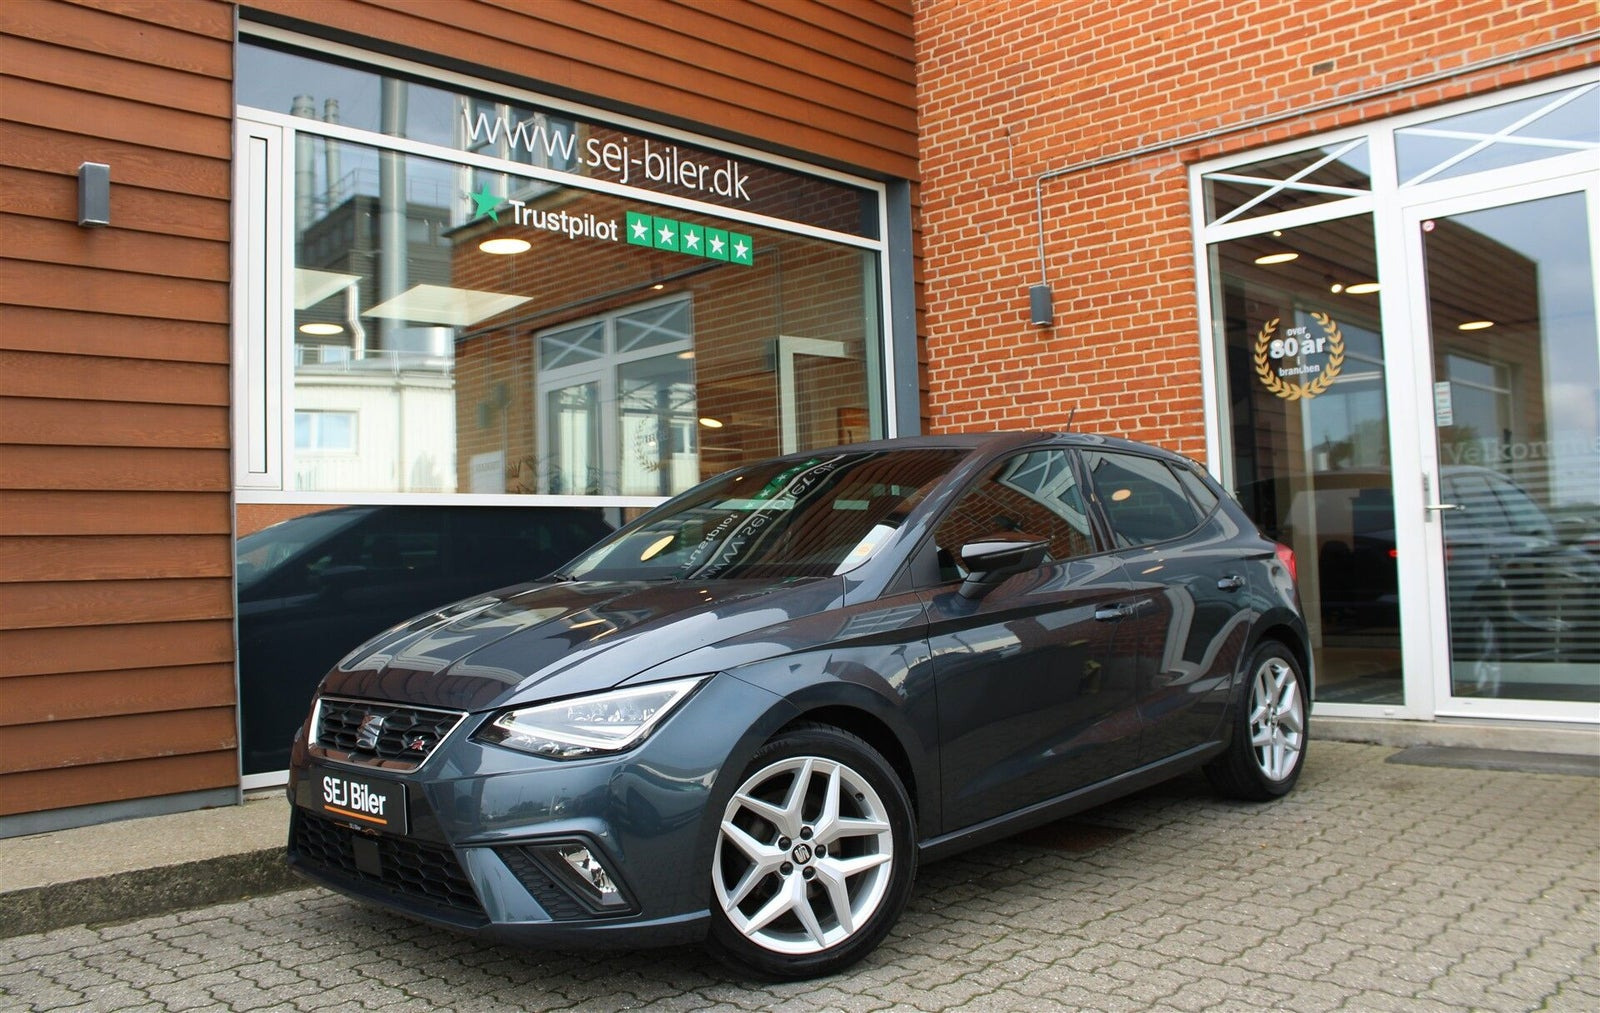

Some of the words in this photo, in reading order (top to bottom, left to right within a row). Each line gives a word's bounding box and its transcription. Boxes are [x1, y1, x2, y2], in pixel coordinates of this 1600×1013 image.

[463, 108, 751, 201] www.sej-biler.dk
[508, 199, 618, 242] Trustpilot
[1270, 338, 1298, 359] 80
[1301, 333, 1326, 355] år
[1287, 326, 1306, 336] over
[323, 775, 348, 807] SEJ
[350, 781, 387, 816] Biler
